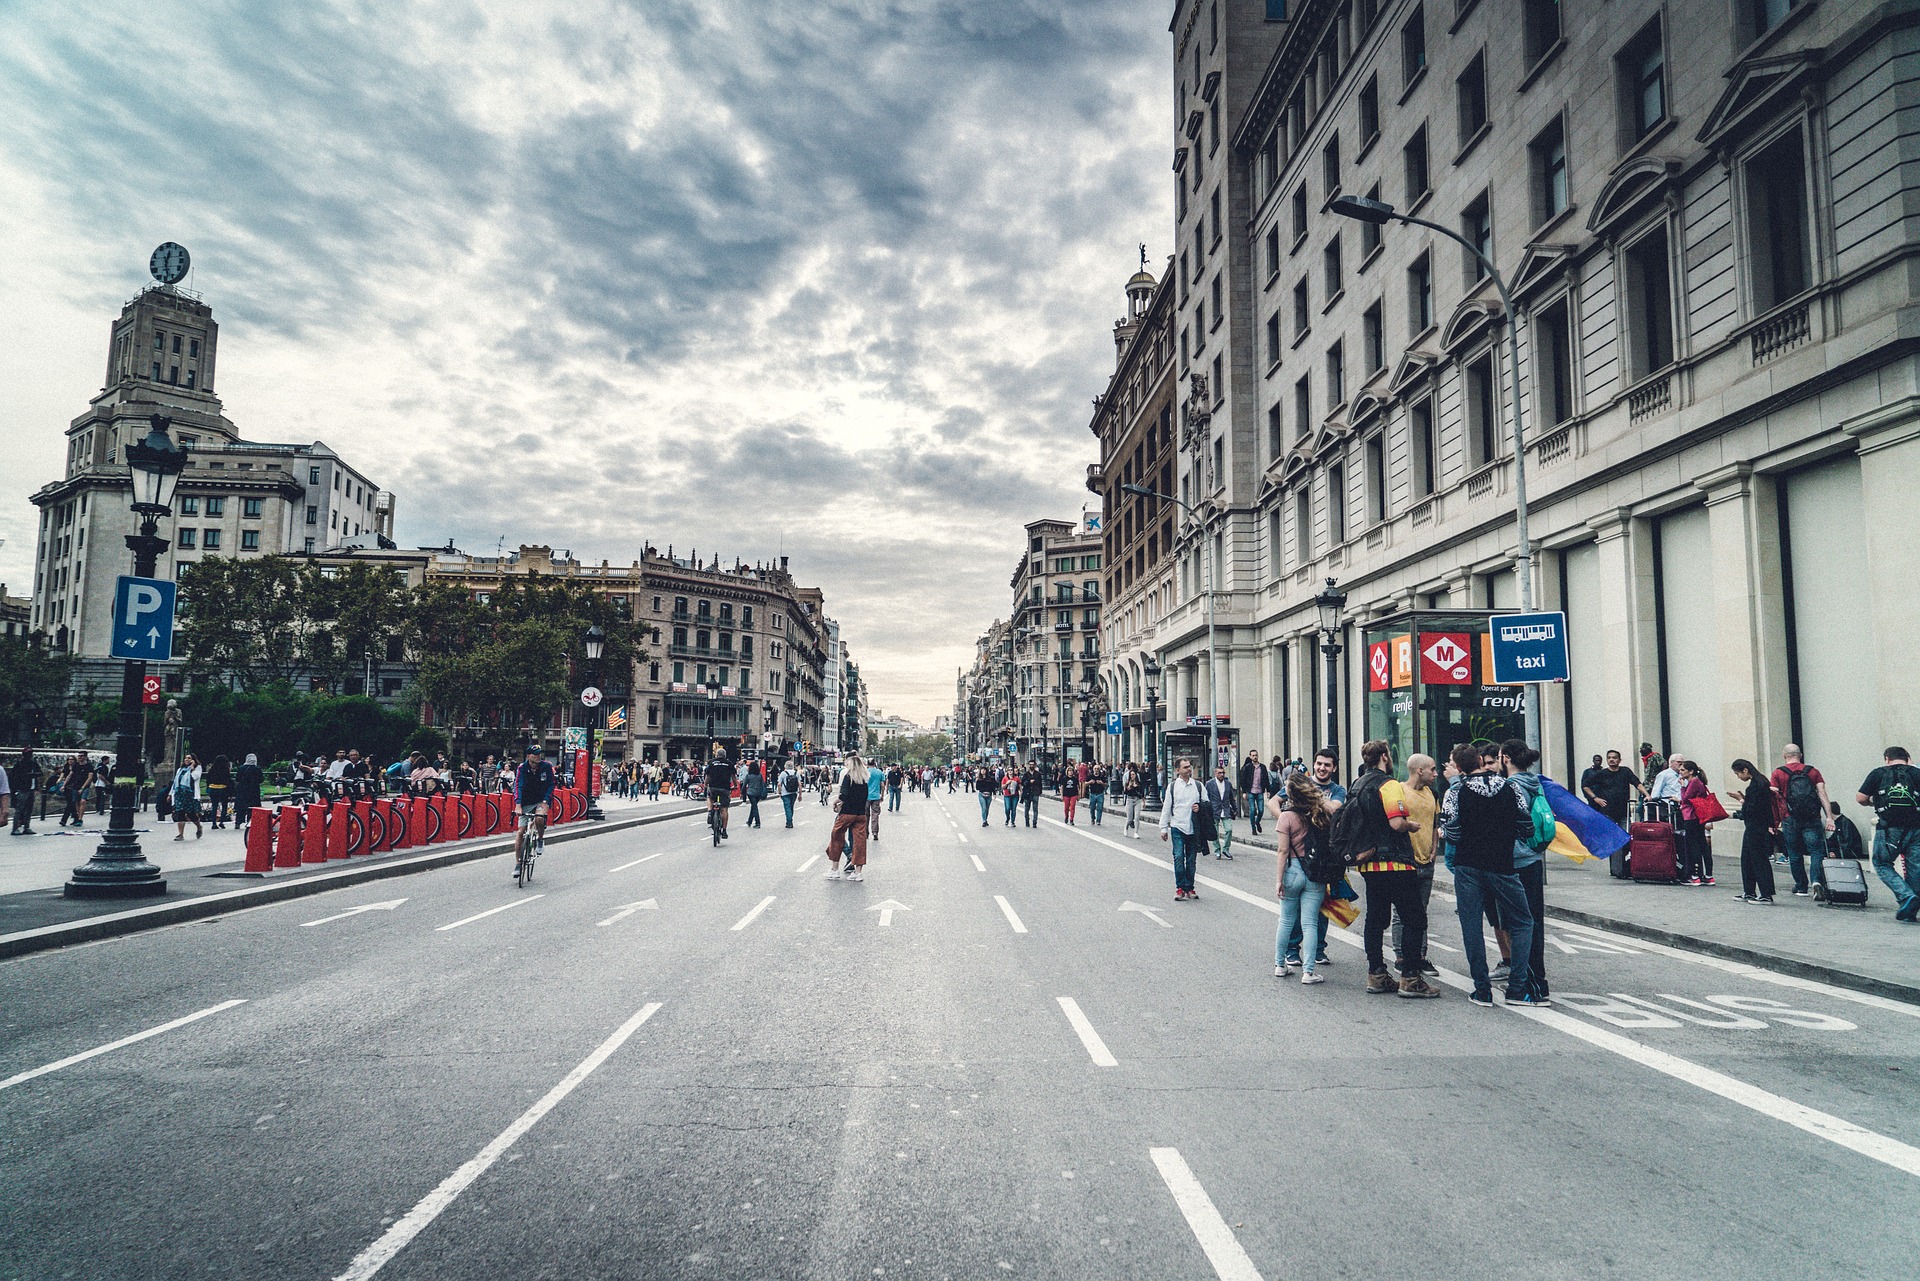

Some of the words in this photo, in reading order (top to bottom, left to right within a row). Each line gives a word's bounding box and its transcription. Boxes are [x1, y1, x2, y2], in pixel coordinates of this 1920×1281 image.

[126, 584, 162, 625] P
[1375, 654, 1382, 669] M
[1399, 641, 1412, 673] R
[1437, 646, 1454, 661] M
[1516, 653, 1546, 669] taxi
[1393, 696, 1412, 715] renfe
[1109, 714, 1118, 726] P
[1549, 992, 1857, 1031] BUS
